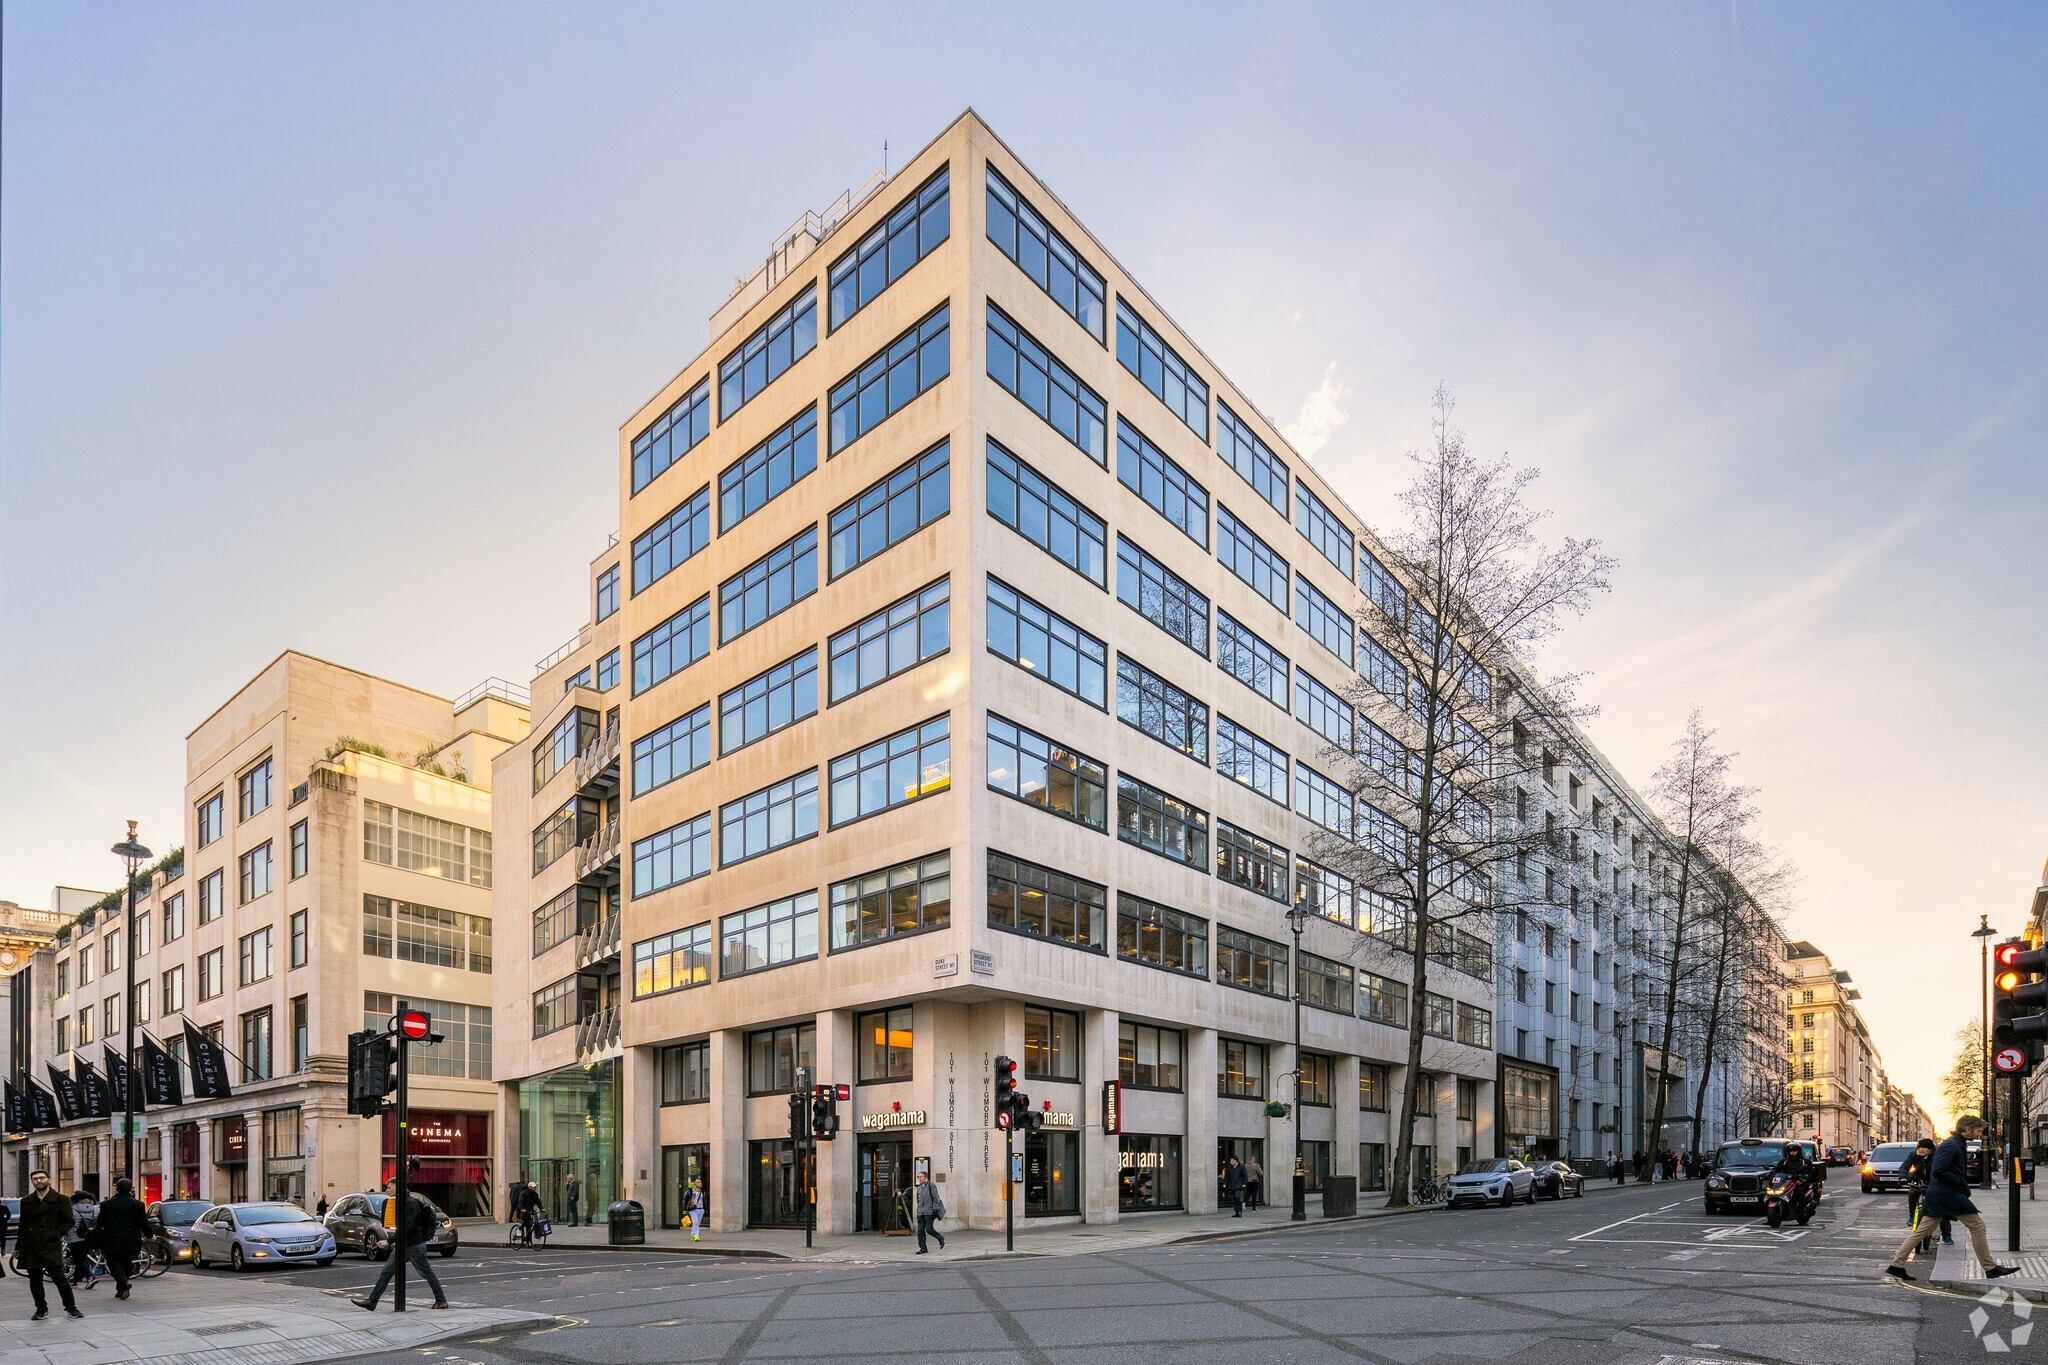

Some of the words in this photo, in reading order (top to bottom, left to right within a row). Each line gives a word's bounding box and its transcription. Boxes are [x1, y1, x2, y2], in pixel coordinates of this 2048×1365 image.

[935, 963, 949, 971] STREET
[156, 1054, 169, 1101] CINEMA
[199, 1043, 218, 1094] CINEMA
[14, 1095, 23, 1130] CINEMA
[36, 1090, 49, 1126] CINEMA
[62, 1080, 80, 1117] CINEMA
[86, 1074, 100, 1115] CINEMA
[1108, 1084, 1117, 1131] wagamama
[411, 1127, 462, 1137] CINEMA
[862, 1110, 925, 1130] wagamama
